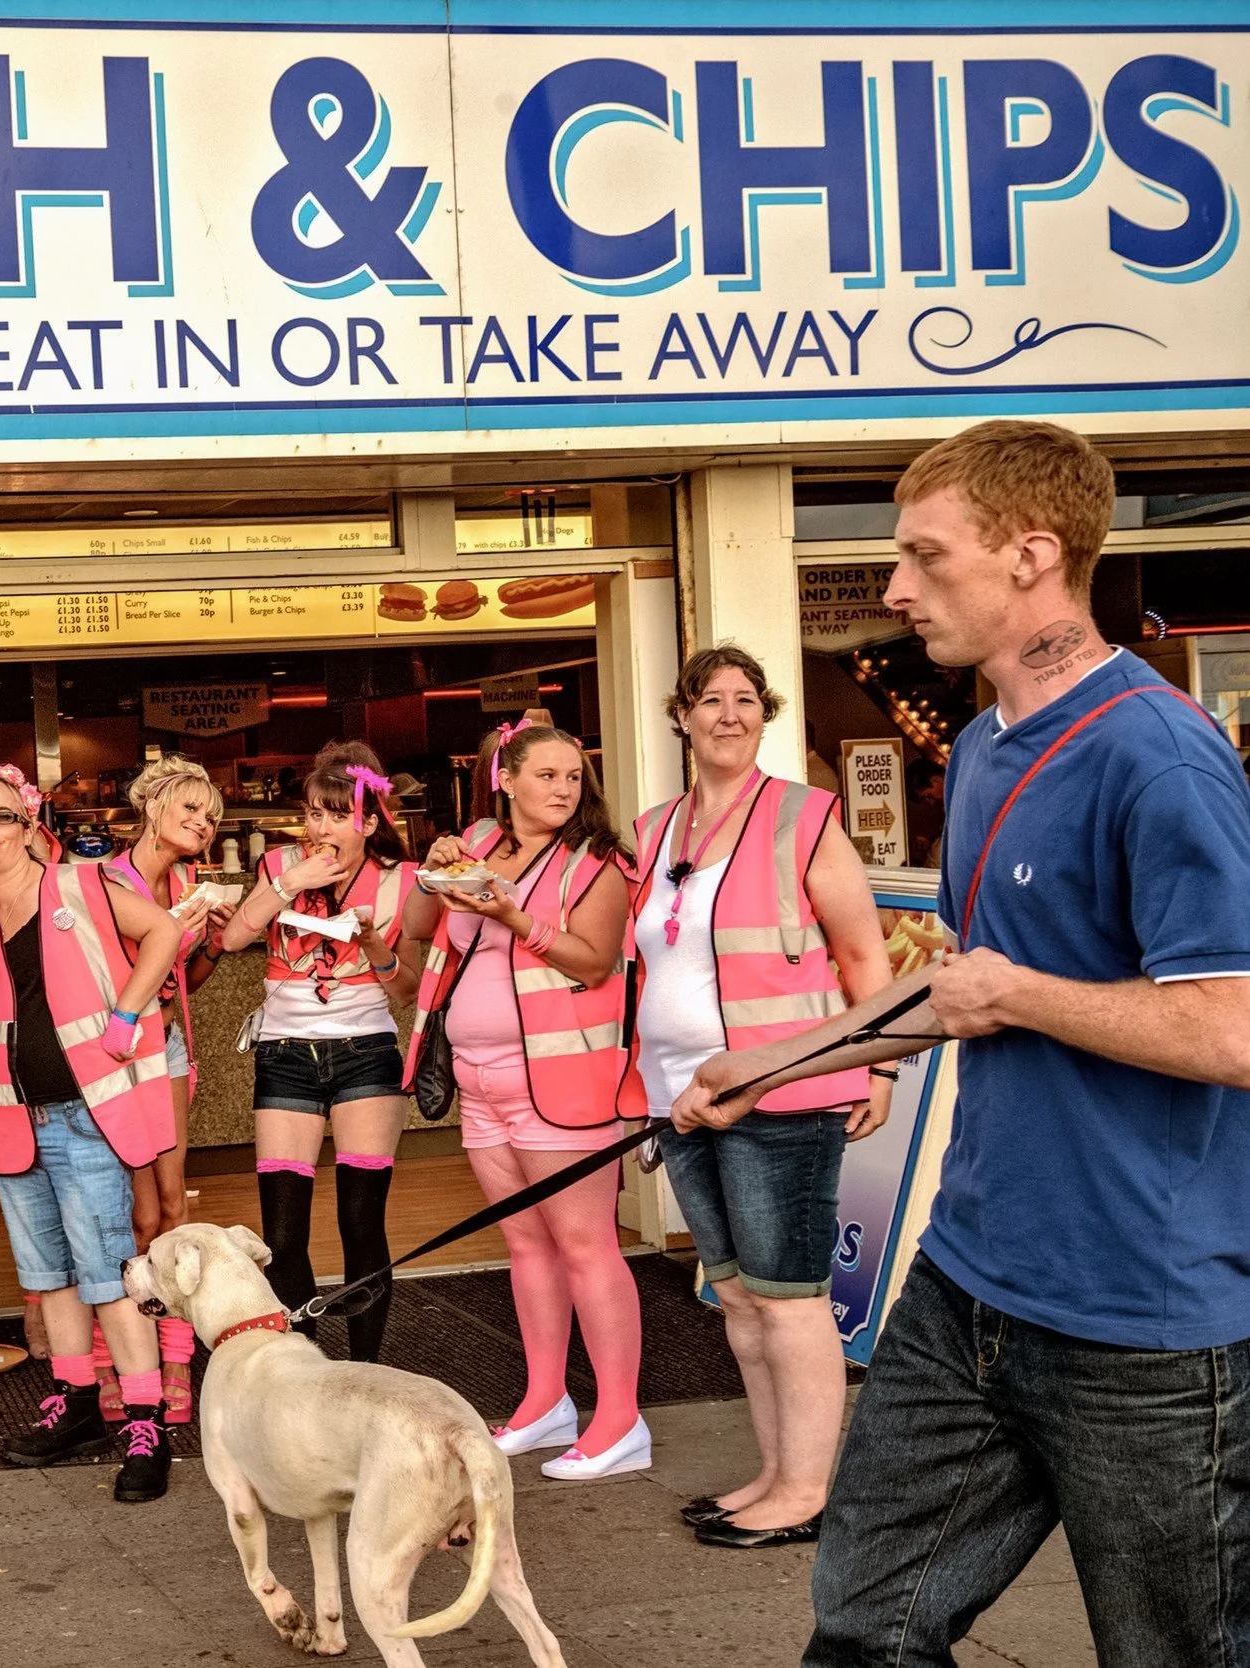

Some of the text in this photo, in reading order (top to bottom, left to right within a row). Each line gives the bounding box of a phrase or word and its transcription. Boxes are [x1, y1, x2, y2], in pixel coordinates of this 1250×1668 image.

[251, 56, 447, 300] &
[505, 54, 1240, 297] CHIPS
[155, 318, 239, 388] IN
[271, 317, 398, 388] OR
[420, 313, 622, 384] TAKE
[649, 309, 878, 380] AWAY
[338, 532, 360, 541] £4.59
[555, 527, 574, 536] Dogs
[90, 540, 106, 550] 60p
[122, 538, 166, 549] Chips Small
[189, 537, 212, 546] £1.60
[246, 534, 292, 545] Fish & Chips
[474, 540, 489, 549] with
[490, 540, 507, 550] chips
[508, 540, 527, 549] £3.3
[805, 568, 893, 584] ORDER YO
[270, 594, 291, 603] Chips
[341, 592, 363, 600] £3.30
[838, 586, 870, 600] PAY
[57, 596, 108, 605] £1.30 £1.50
[125, 600, 148, 608] Curry
[199, 597, 215, 606] 70p
[10, 608, 30, 618] Pepsi
[57, 605, 109, 615] £1.30 £1.50
[200, 608, 215, 618] 20p
[250, 605, 306, 616] Burger & Chips
[342, 603, 364, 612] £3.39
[58, 615, 109, 624] £1.30 £1.50
[125, 611, 147, 619] Bread
[163, 610, 181, 618] Slice
[834, 608, 893, 621] SEATING
[58, 625, 110, 634] £1.30 £1.50
[818, 624, 850, 635] WAY
[1033, 647, 1098, 685] TURBO TED
[150, 688, 260, 703] RESTAURANT
[483, 689, 537, 702] MACHINE
[171, 702, 241, 716] SEATING
[185, 717, 229, 730] AREA
[855, 754, 892, 768] PLEASE
[857, 768, 892, 782] ORDER
[861, 783, 890, 796] FOOD
[858, 810, 891, 827] HERE
[878, 843, 896, 855] EAT
